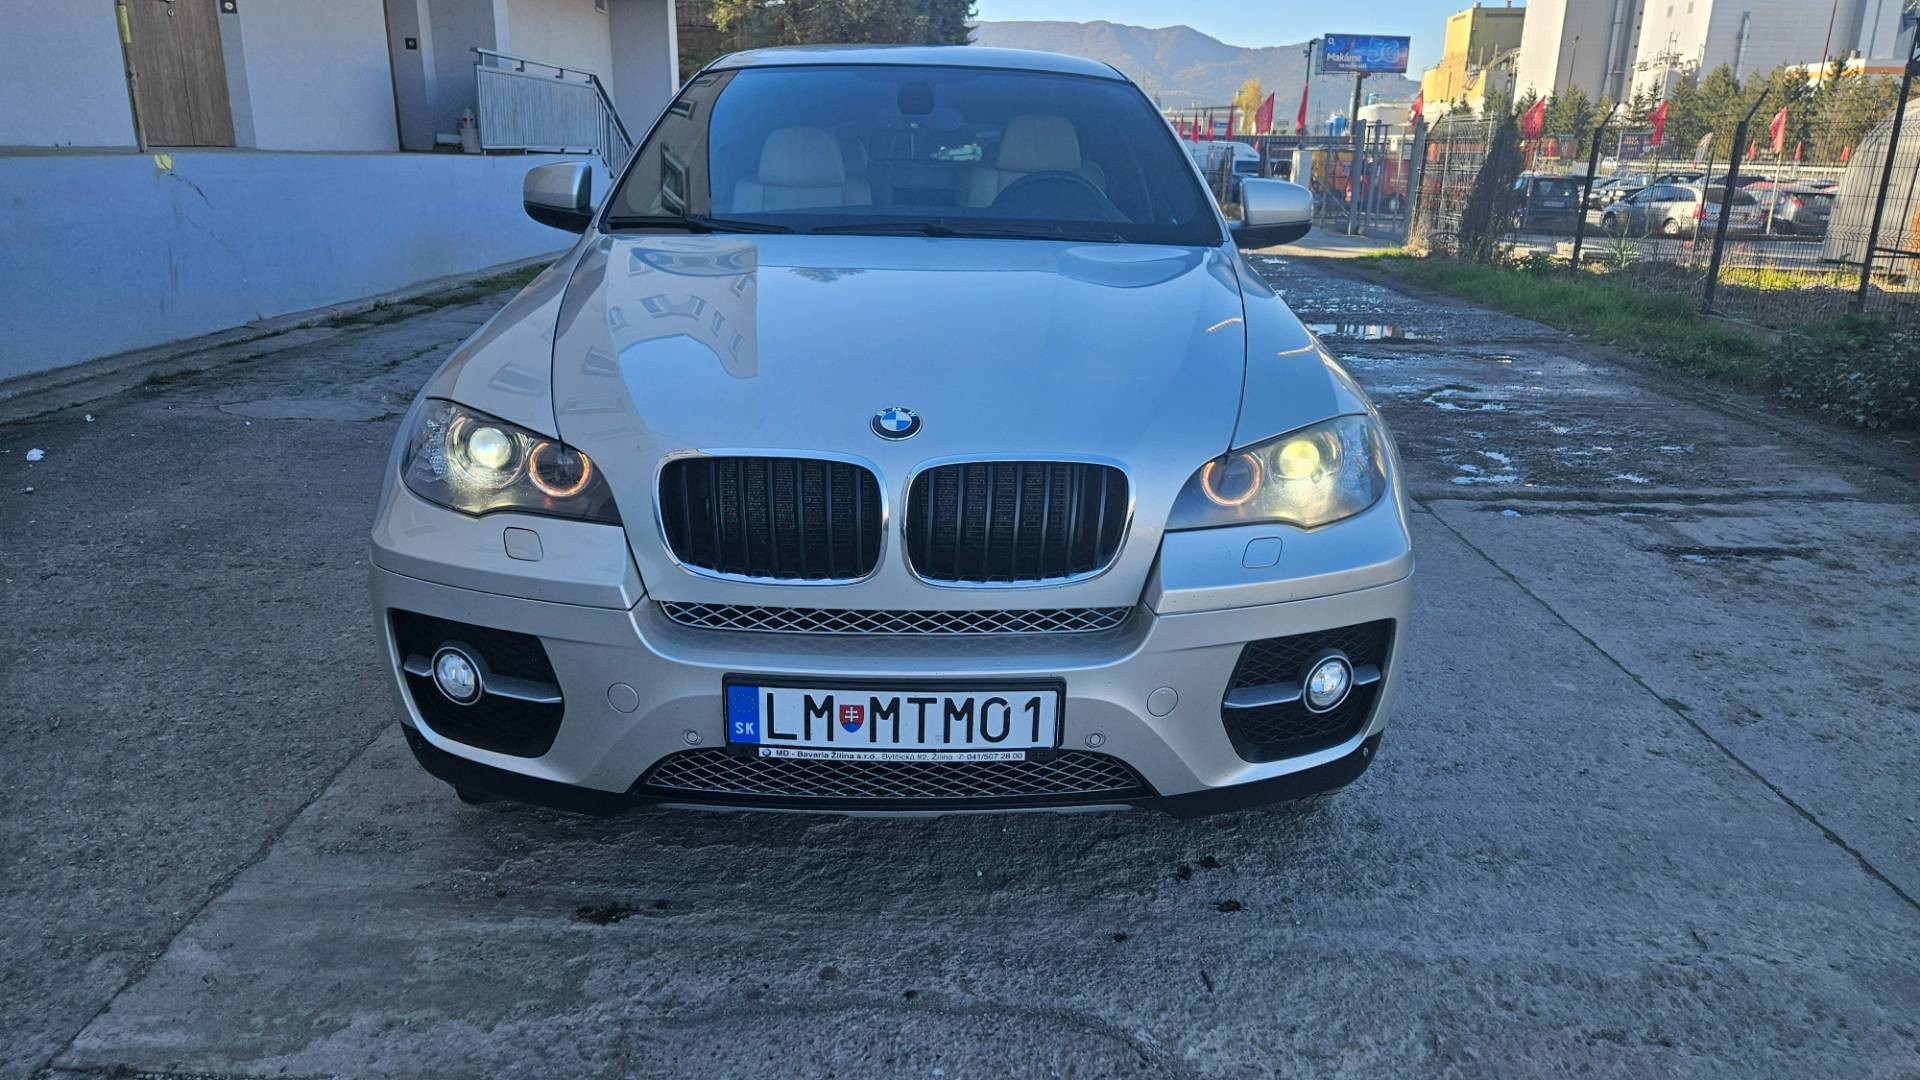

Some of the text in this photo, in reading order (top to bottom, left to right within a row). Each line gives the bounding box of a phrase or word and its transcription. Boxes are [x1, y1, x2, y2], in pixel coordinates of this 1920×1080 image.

[766, 692, 835, 742] LM
[735, 721, 755, 735] SK
[776, 749, 790, 757] MD
[797, 750, 829, 759] Bavaria
[831, 750, 855, 760] Žilina
[932, 752, 953, 760] Žilina
[1012, 752, 1023, 760] 00
